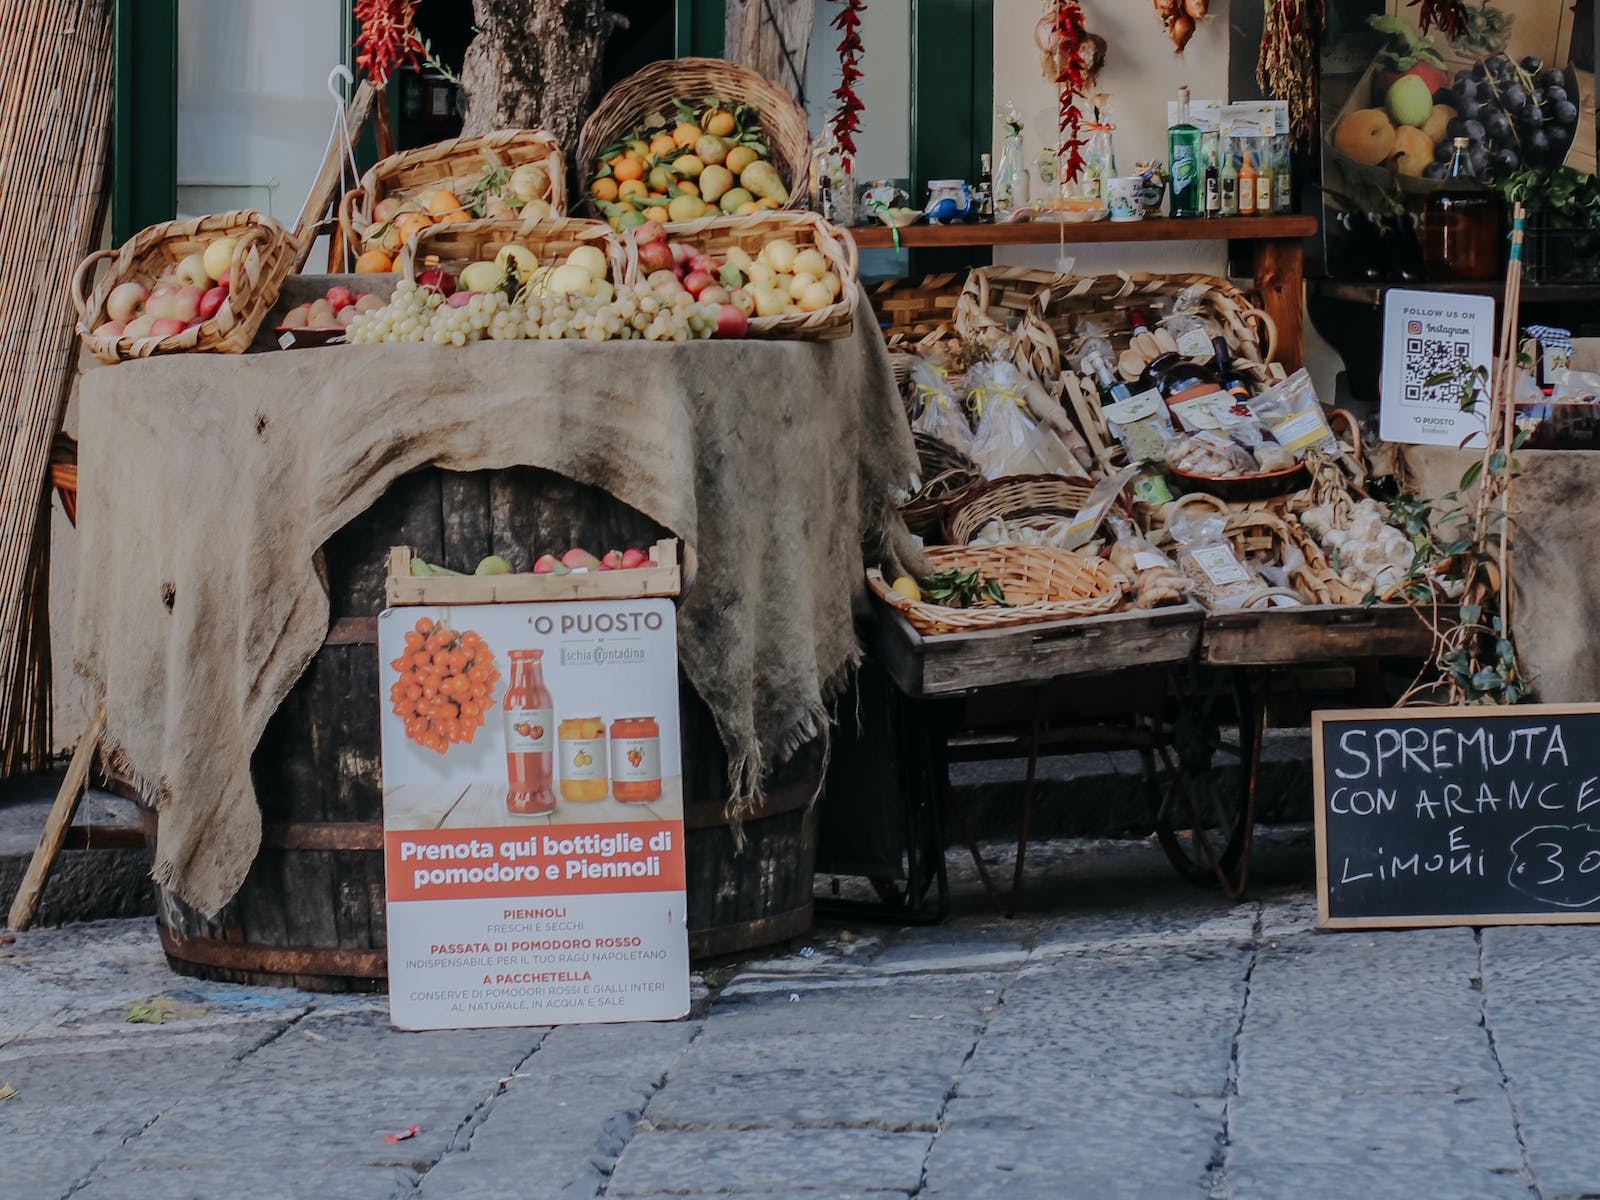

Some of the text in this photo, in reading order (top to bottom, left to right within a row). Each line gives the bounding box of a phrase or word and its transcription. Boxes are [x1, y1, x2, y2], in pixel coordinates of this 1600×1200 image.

[1403, 307, 1443, 317] FOLLOW
[1462, 312, 1476, 320] ON
[1426, 323, 1470, 337] Instagram
[1423, 417, 1455, 426] PUOSTO
[561, 612, 663, 634] PUOSTO
[560, 648, 592, 666] Ischia
[1335, 724, 1568, 779] SPREMUTA
[1331, 776, 1600, 819] CON ARANCE
[400, 831, 671, 861] Prenota qui bottiglie di
[1448, 826, 1471, 852] E
[414, 857, 660, 888] pomodoro e Piennoli
[503, 908, 567, 920] PIENNOLI
[487, 921, 584, 933] FRESCHI E SECCHI
[431, 936, 641, 955] PASSATA DI POMODORO ROSSO
[406, 956, 493, 969] INDISPENSABILE
[497, 956, 517, 966] PER
[520, 956, 529, 965] IL
[532, 954, 555, 965] TUO
[592, 950, 666, 961] NAPOLETANO
[483, 971, 592, 985] A PACCHETELLA
[410, 982, 665, 1001] CONSERVE DI POMODORI ROSSI E GIALLI INTERI
[451, 996, 624, 1013] AL NATURALE, IN ACQUA E SALE
